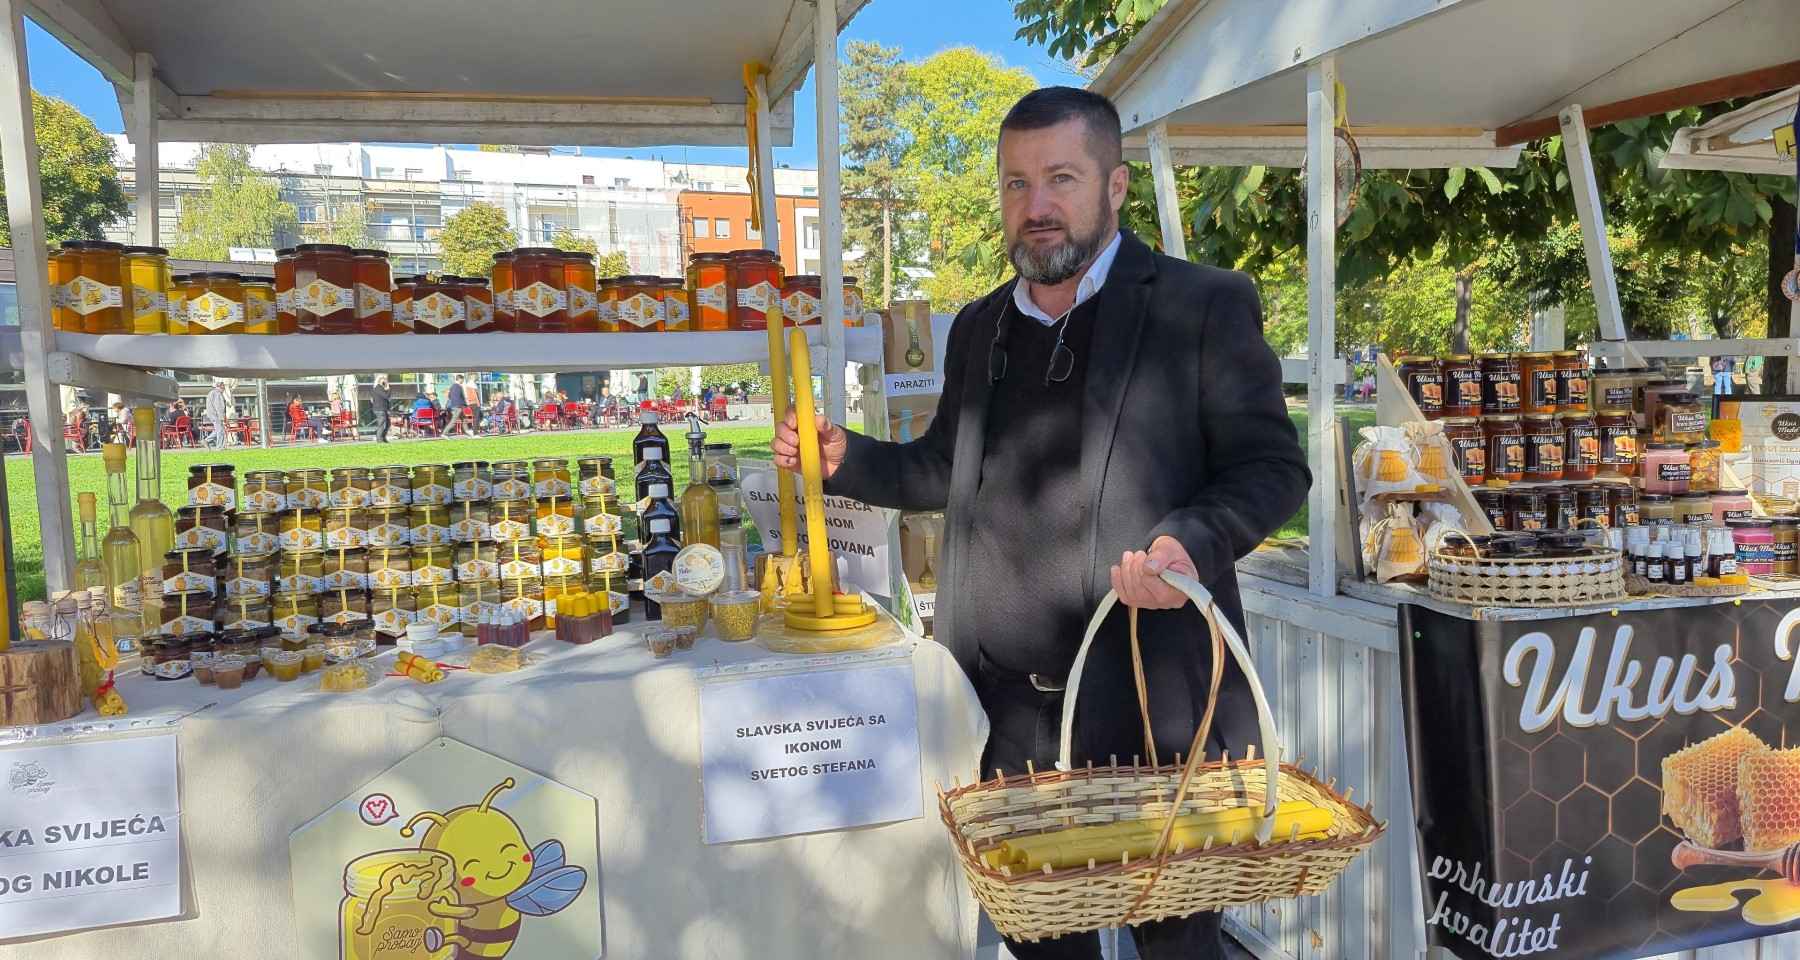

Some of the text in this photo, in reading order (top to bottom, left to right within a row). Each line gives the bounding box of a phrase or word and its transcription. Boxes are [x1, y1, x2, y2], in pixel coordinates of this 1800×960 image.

[894, 378, 935, 390] PARAZITI
[1503, 624, 1736, 733] Ukus
[736, 714, 886, 738] SLAVSKA SVIJEĆA SA
[785, 738, 842, 754] IKONOM
[751, 758, 876, 781] SVETOG STEFANA
[44, 813, 166, 844] SVIJEĆA
[43, 862, 149, 891] NIKOLE
[1426, 856, 1593, 908] vrhunski
[1426, 891, 1561, 959] kvalitet
